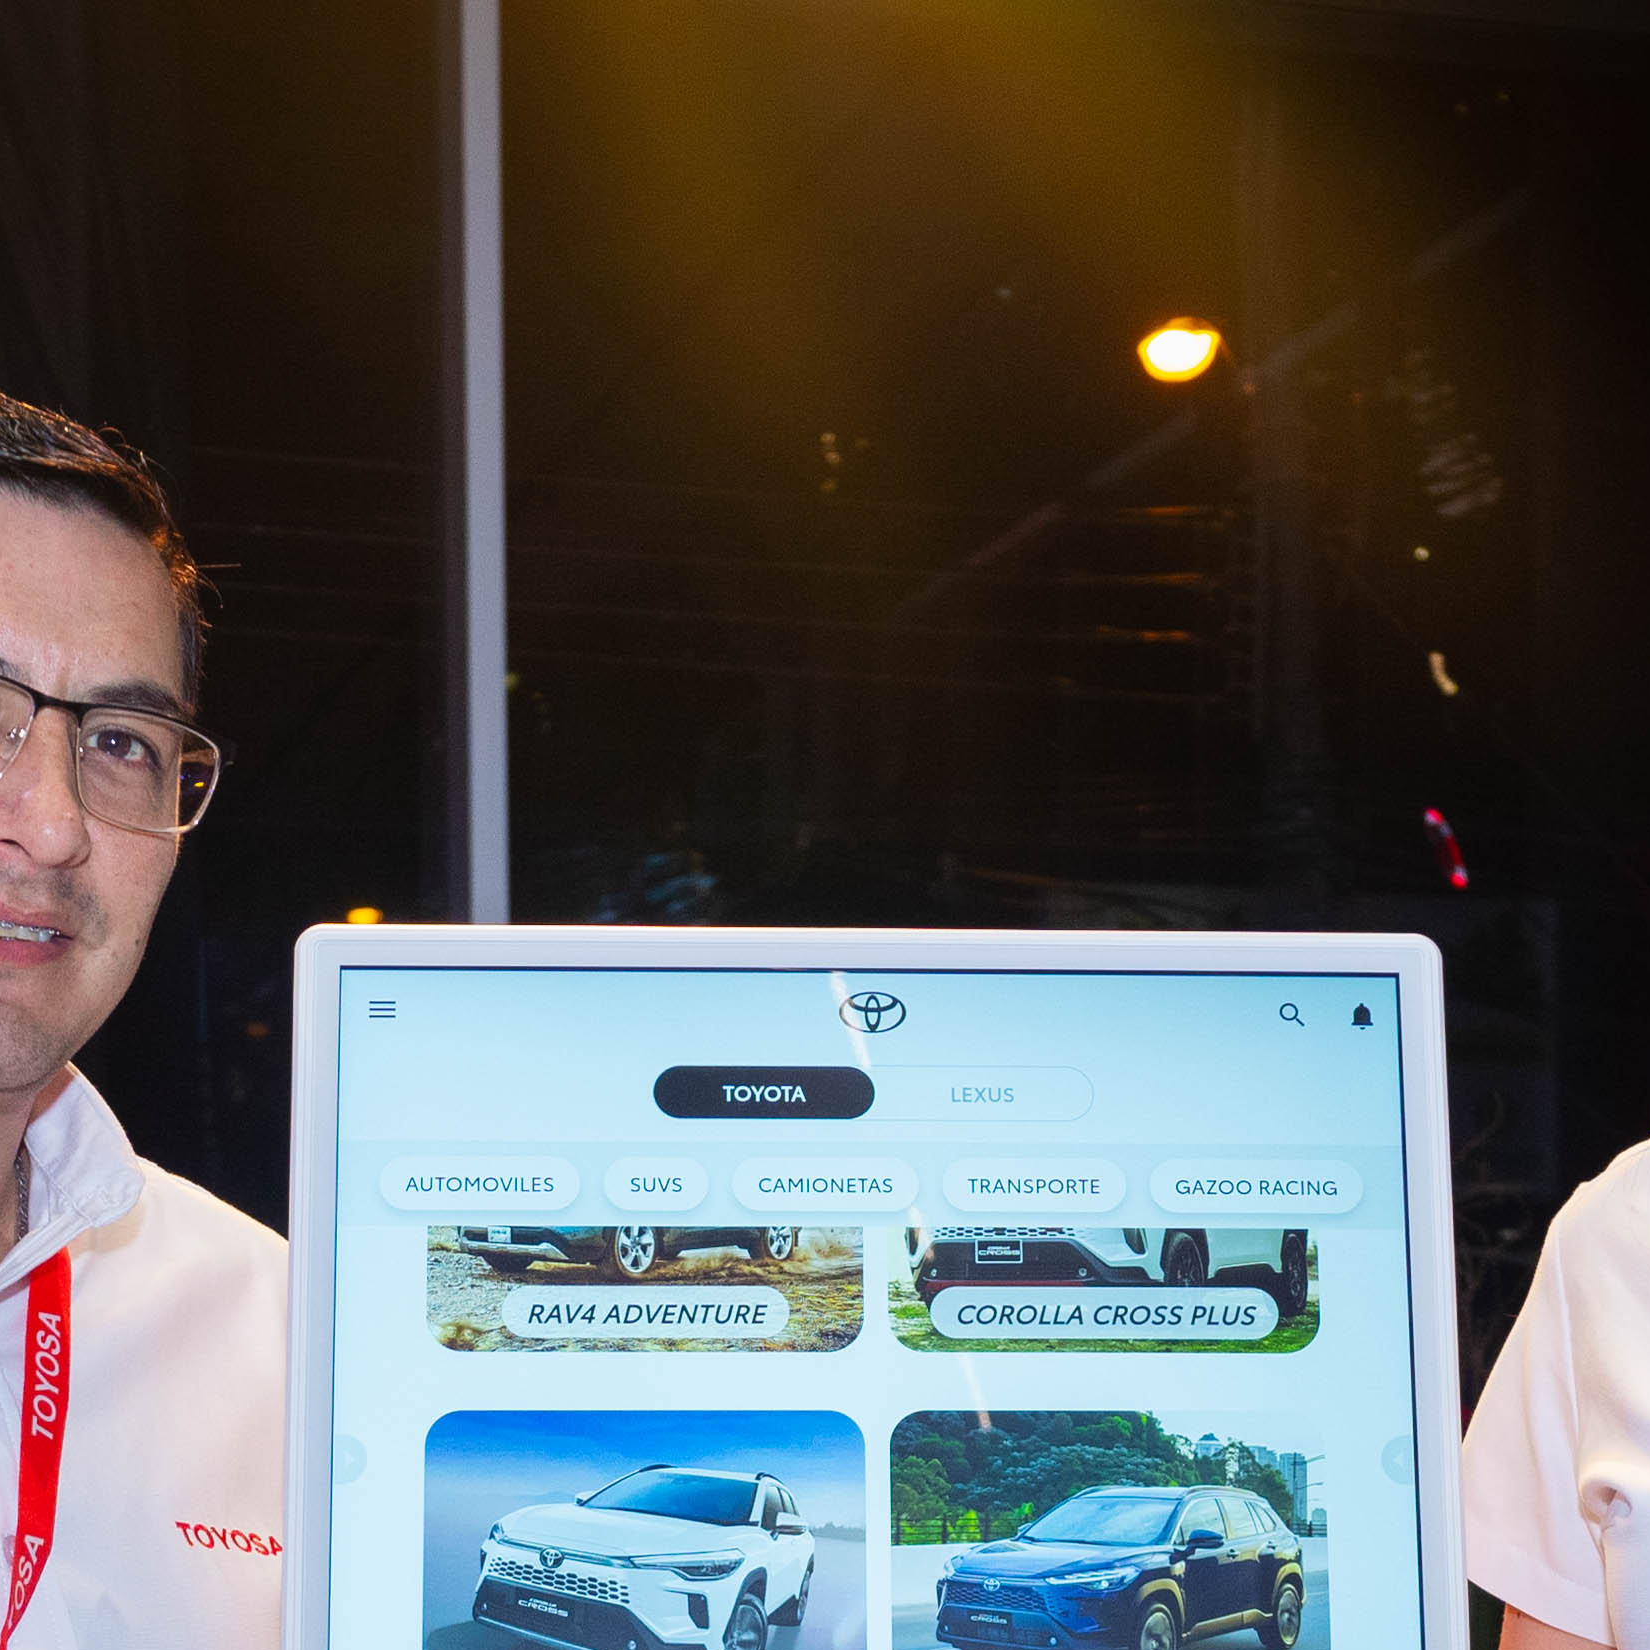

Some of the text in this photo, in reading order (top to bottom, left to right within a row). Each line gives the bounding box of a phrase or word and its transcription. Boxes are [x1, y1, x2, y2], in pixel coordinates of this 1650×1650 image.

[722, 1084, 807, 1104] TOYOTA
[950, 1086, 1015, 1103] LEXUS
[404, 1175, 555, 1194] AUTOMOVILES
[630, 1176, 683, 1194] SUVS
[758, 1176, 893, 1195] CAMIONETAS
[967, 1177, 1101, 1195] TRANSPORTE
[1174, 1178, 1339, 1198] GAZOO RACING
[527, 1302, 769, 1326] RAV4 ADVENTURE
[956, 1303, 1258, 1326] COROLLA CROSS PLUS
[31, 1311, 62, 1441] TOYOSA
[175, 1520, 283, 1557] TOYOSA
